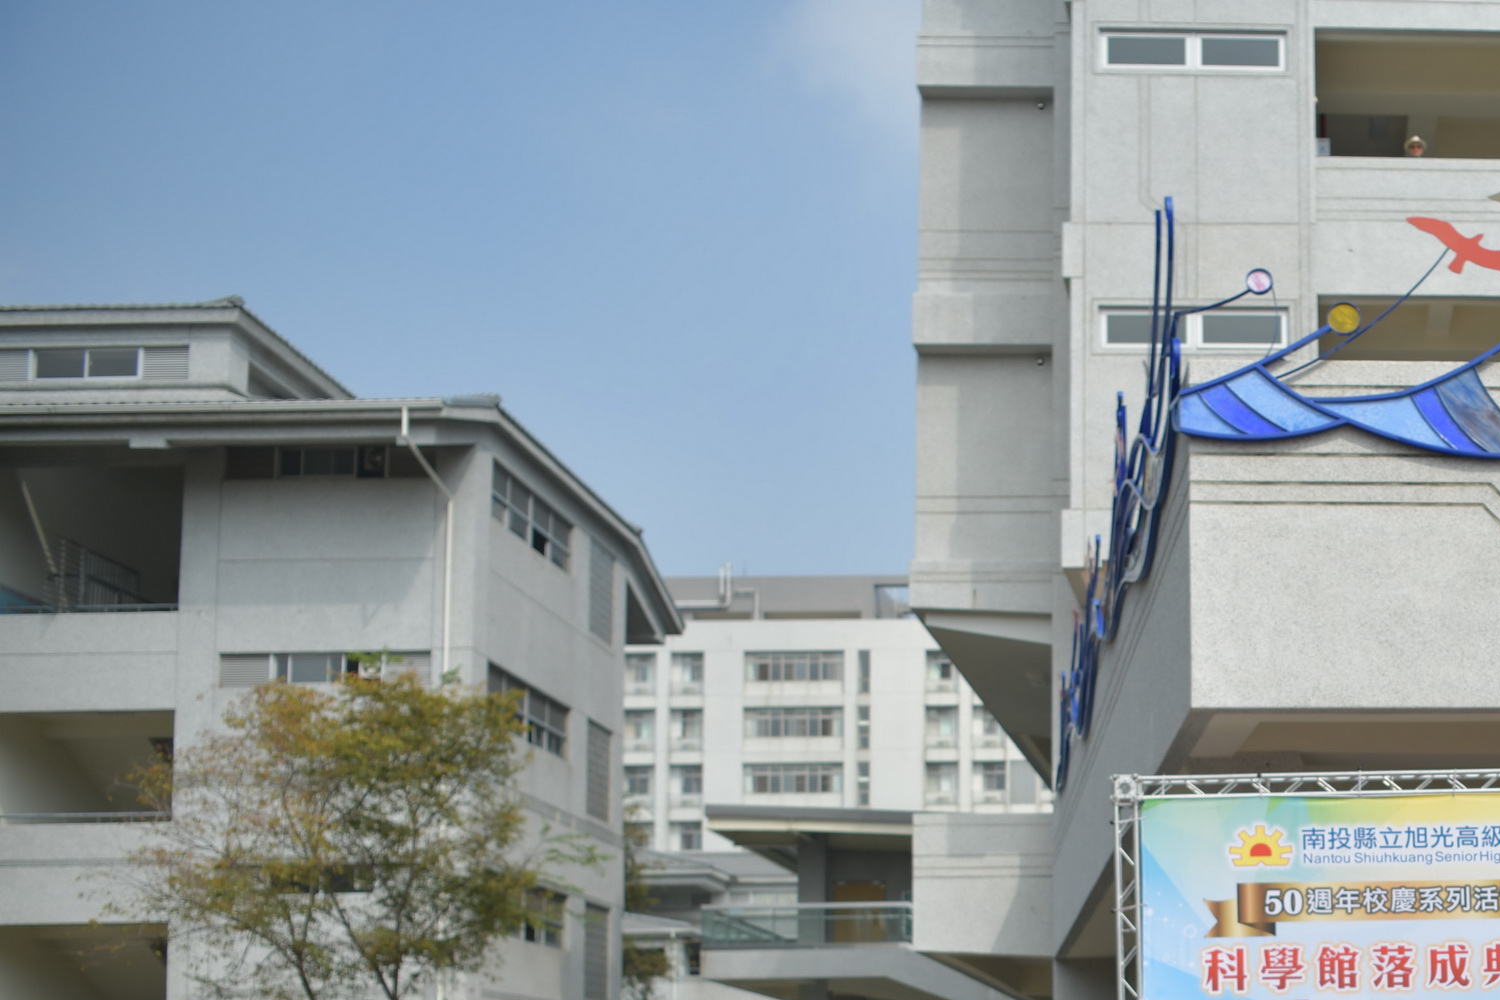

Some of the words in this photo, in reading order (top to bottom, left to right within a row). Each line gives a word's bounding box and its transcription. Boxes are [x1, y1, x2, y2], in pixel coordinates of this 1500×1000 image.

[1303, 852, 1350, 864] Nantou
[1354, 851, 1433, 865] Shiuhkuang
[1435, 851, 1477, 863] Senior
